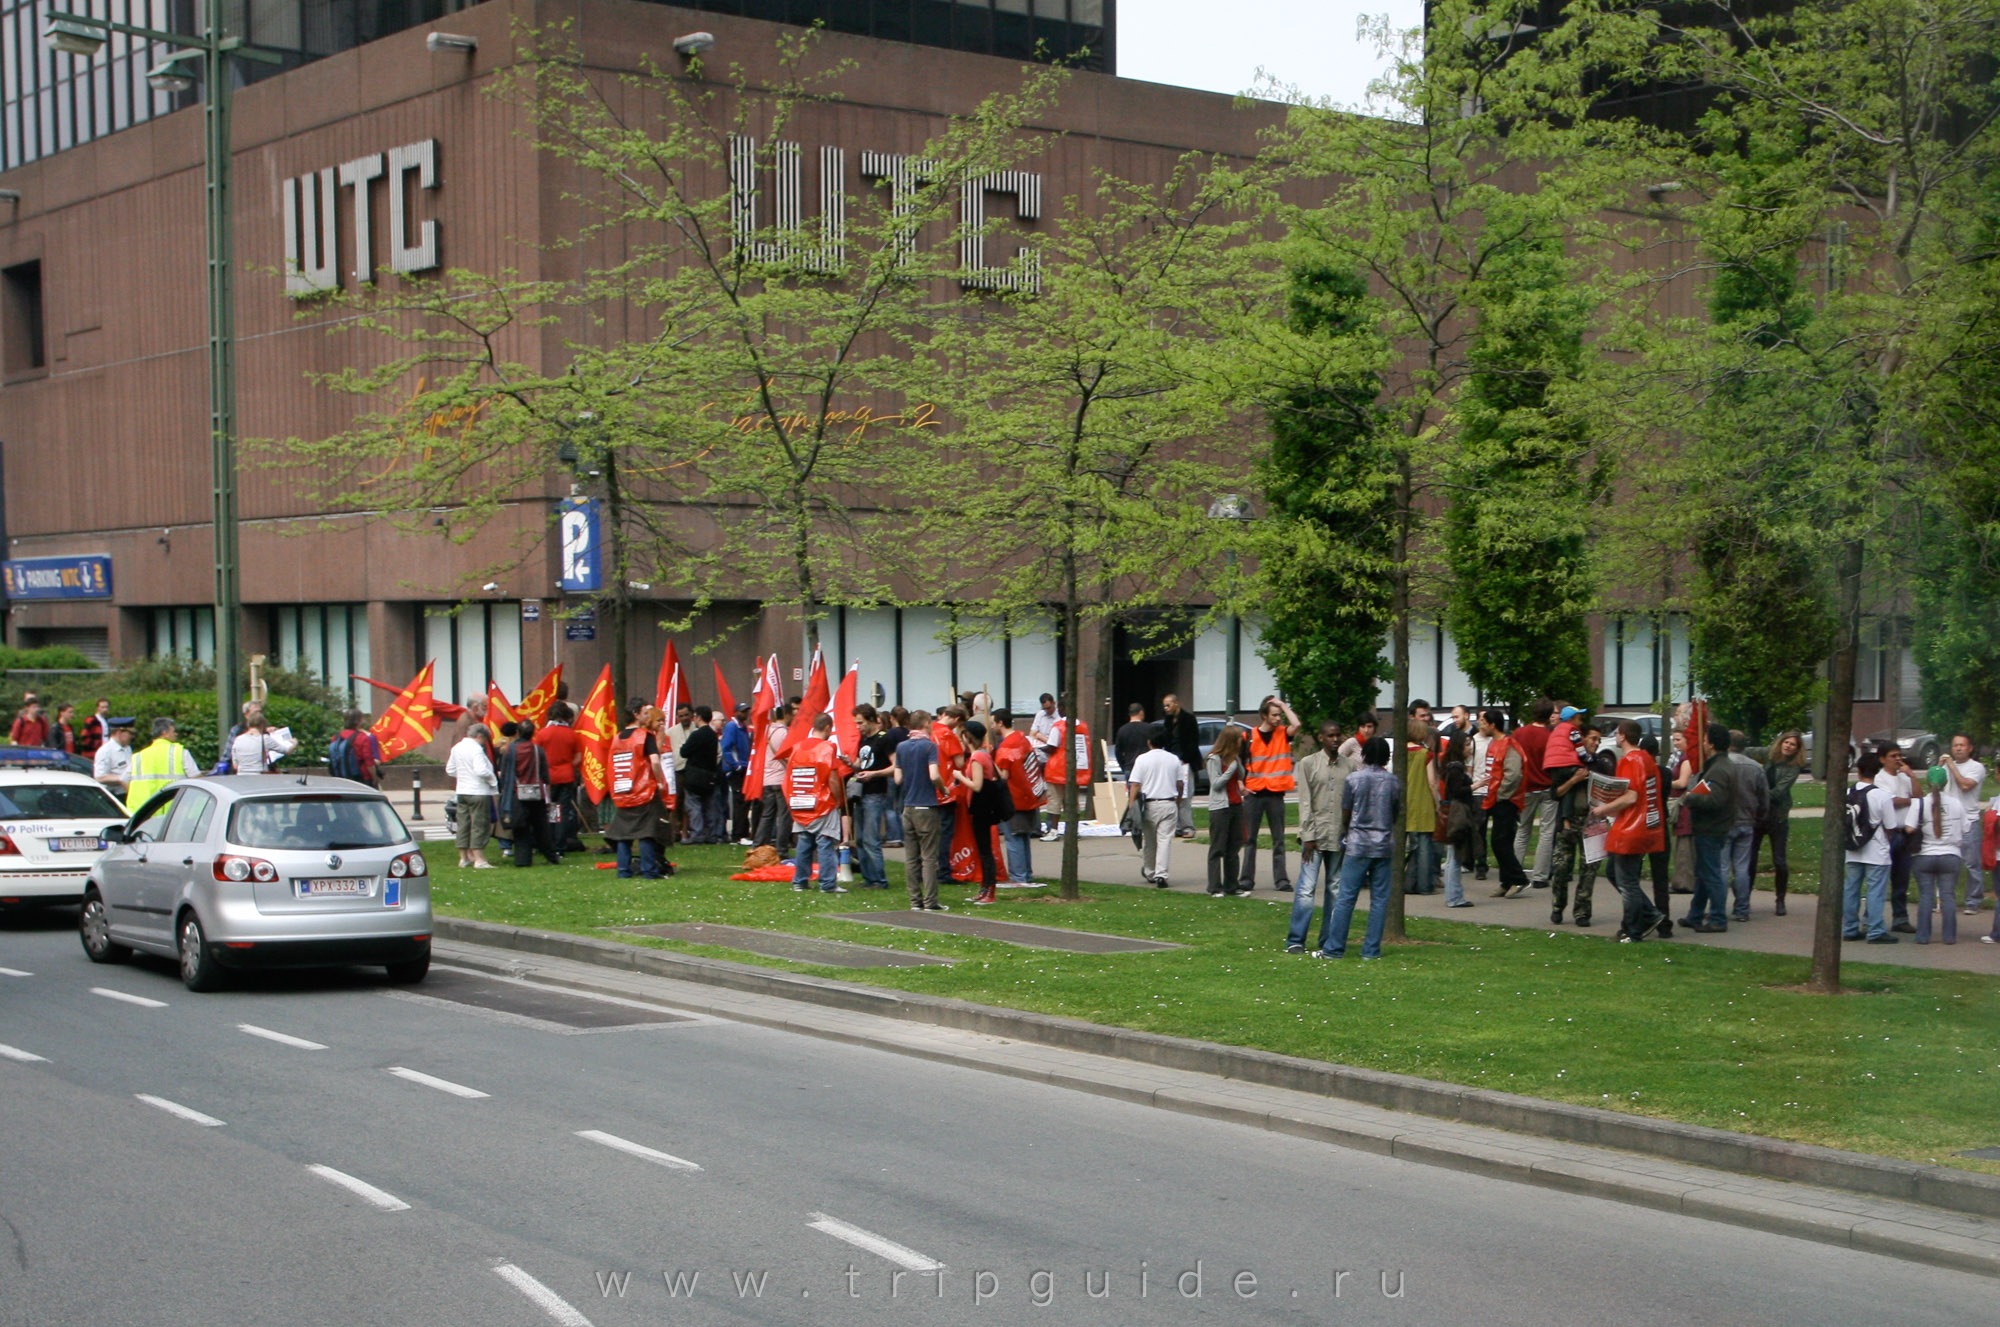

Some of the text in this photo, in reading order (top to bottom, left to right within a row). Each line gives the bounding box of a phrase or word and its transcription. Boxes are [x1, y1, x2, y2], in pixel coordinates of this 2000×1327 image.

[283, 138, 440, 298] WTC
[730, 134, 1041, 294] WTC
[562, 511, 589, 580] P
[26, 568, 61, 588] PARKING
[20, 824, 54, 834] Politie
[358, 879, 367, 890] B
